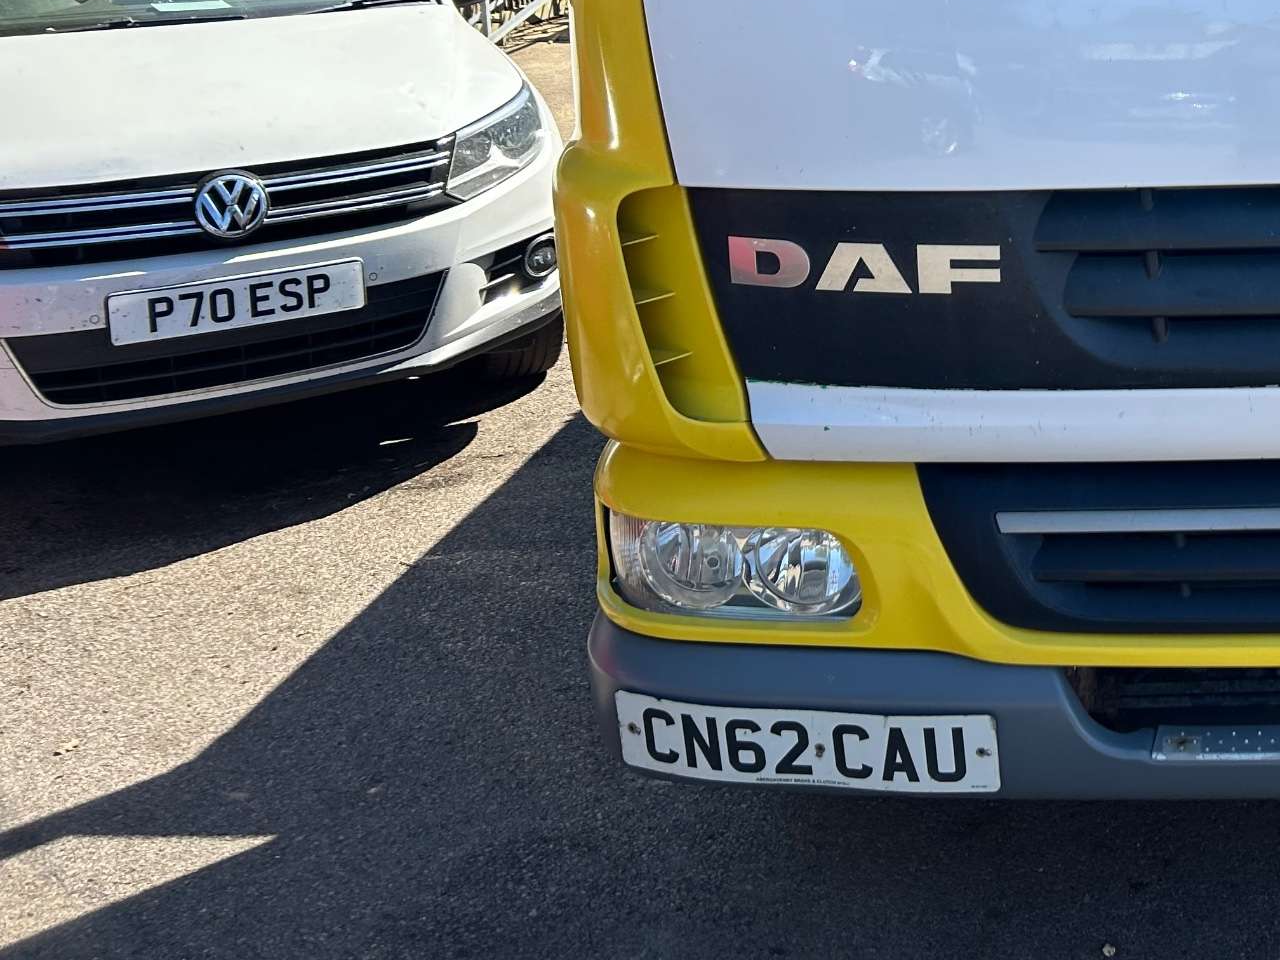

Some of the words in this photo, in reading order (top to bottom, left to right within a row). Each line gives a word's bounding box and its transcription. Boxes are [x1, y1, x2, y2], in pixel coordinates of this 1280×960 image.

[728, 236, 1001, 294] DAF
[147, 287, 236, 333] P70
[249, 272, 331, 319] ESP
[642, 707, 814, 775] CN62
[831, 724, 967, 783] CAU
